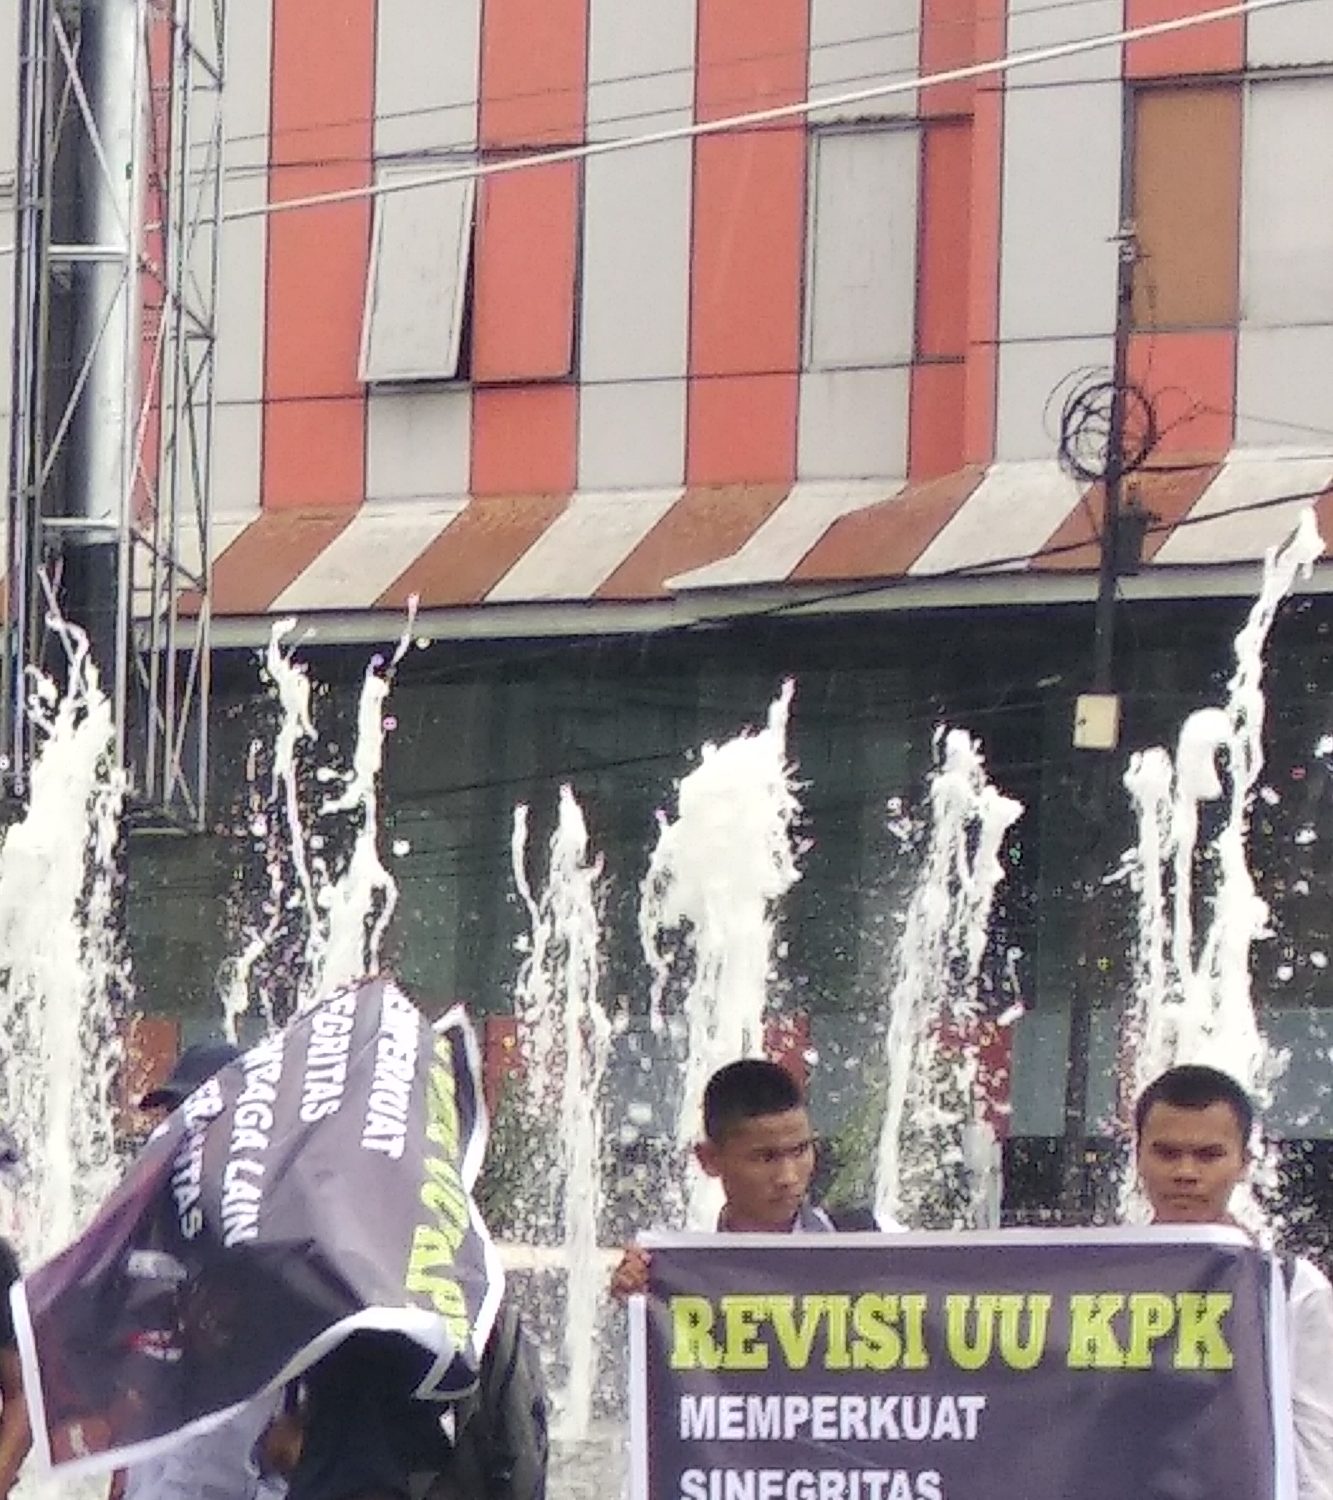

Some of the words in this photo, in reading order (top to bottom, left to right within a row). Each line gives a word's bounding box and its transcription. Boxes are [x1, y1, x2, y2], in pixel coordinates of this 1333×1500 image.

[298, 988, 358, 1123] EGRITAS
[220, 1158, 267, 1249] LAIN
[668, 1293, 929, 1370] REVISI
[945, 1293, 1052, 1370] UU
[1066, 1293, 1234, 1370] KPK
[679, 1395, 987, 1441] MEMPERKUAT
